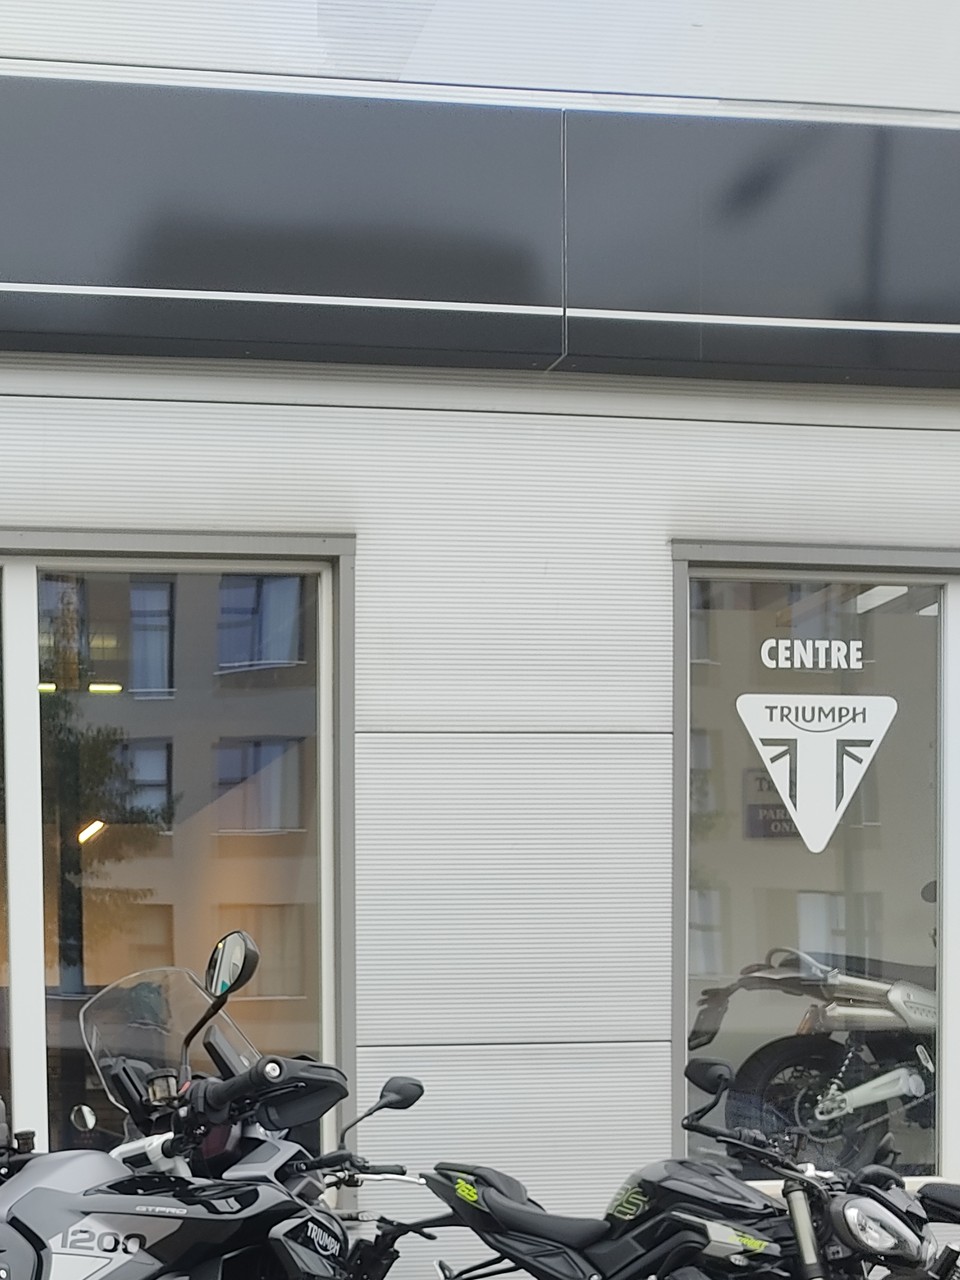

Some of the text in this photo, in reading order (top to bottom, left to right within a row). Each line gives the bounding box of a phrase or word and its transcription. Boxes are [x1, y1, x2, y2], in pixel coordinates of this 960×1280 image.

[760, 638, 864, 669] CENTRE
[764, 705, 868, 732] TRIUMPH
[61, 1229, 147, 1254] 1200
[307, 1221, 340, 1256] TRIUMPH
